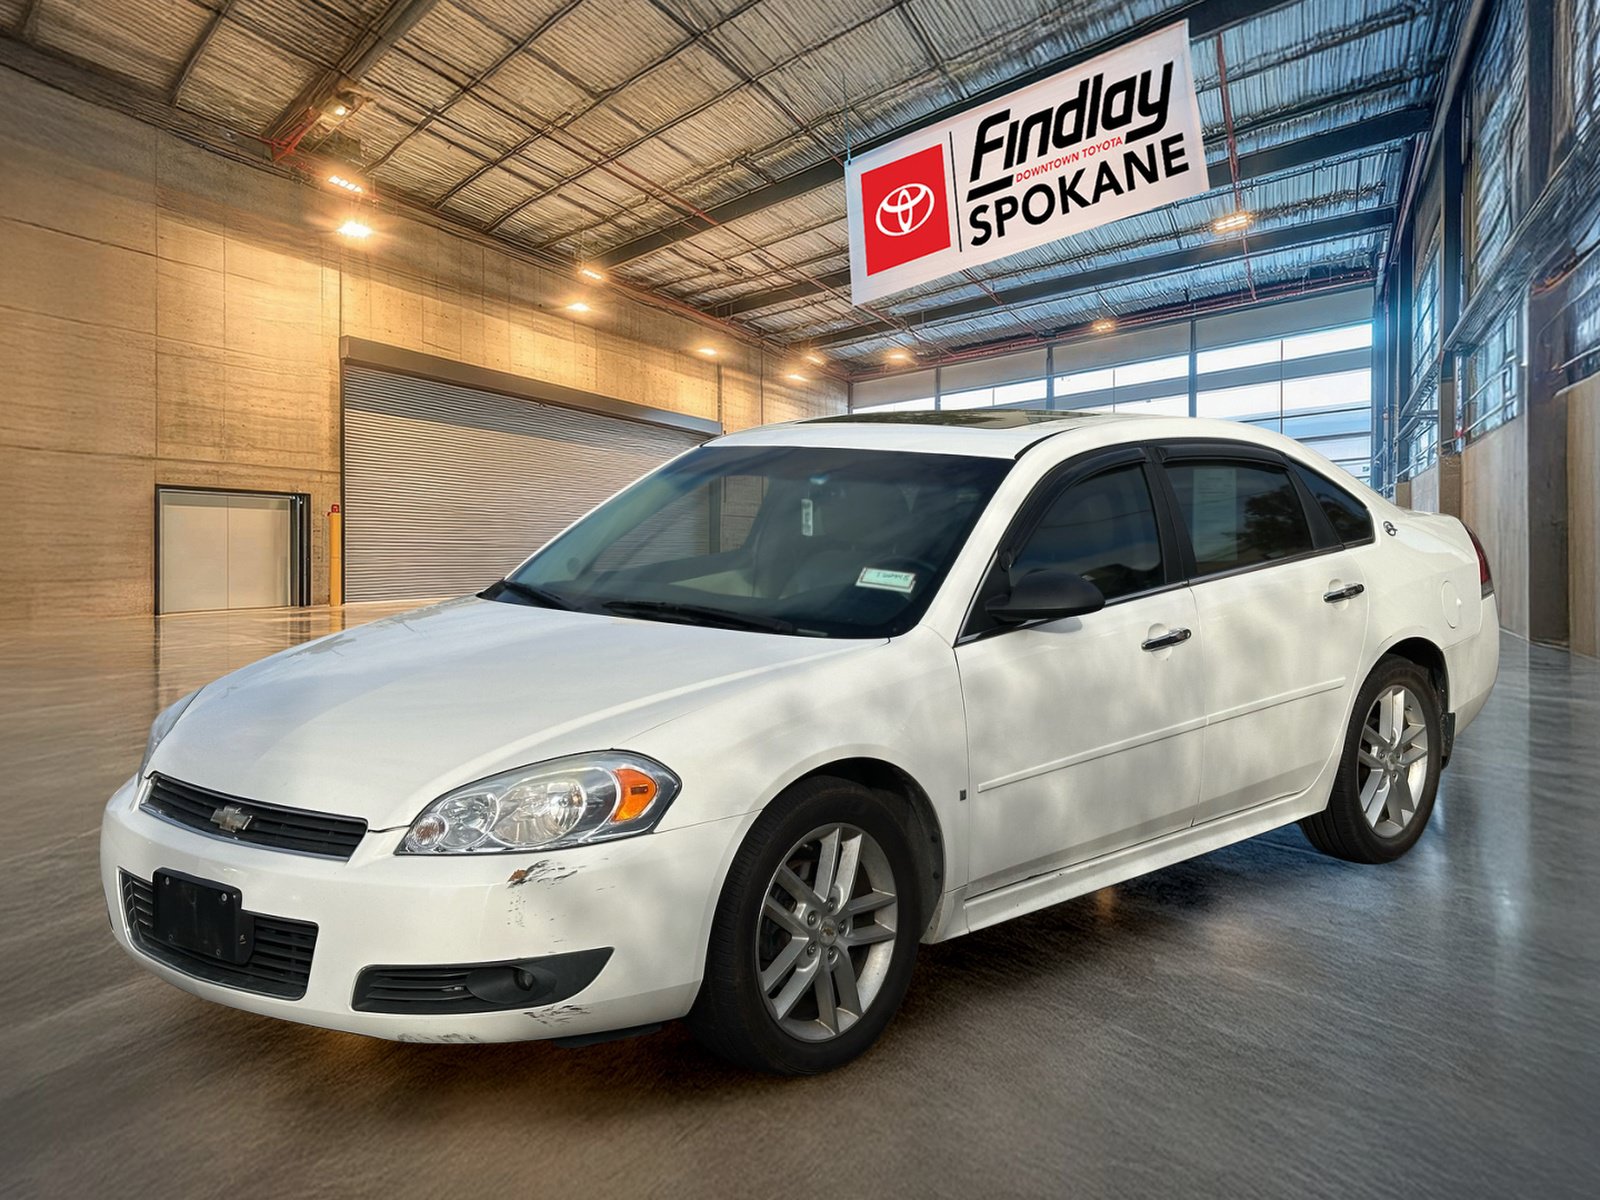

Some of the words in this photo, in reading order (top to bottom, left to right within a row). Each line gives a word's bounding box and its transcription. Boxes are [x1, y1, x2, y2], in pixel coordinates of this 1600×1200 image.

[968, 61, 1174, 183] Findlay
[1016, 152, 1079, 182] DOWNTOWN
[1082, 136, 1123, 158] TOYOTA
[970, 132, 1190, 246] SPOKANE
